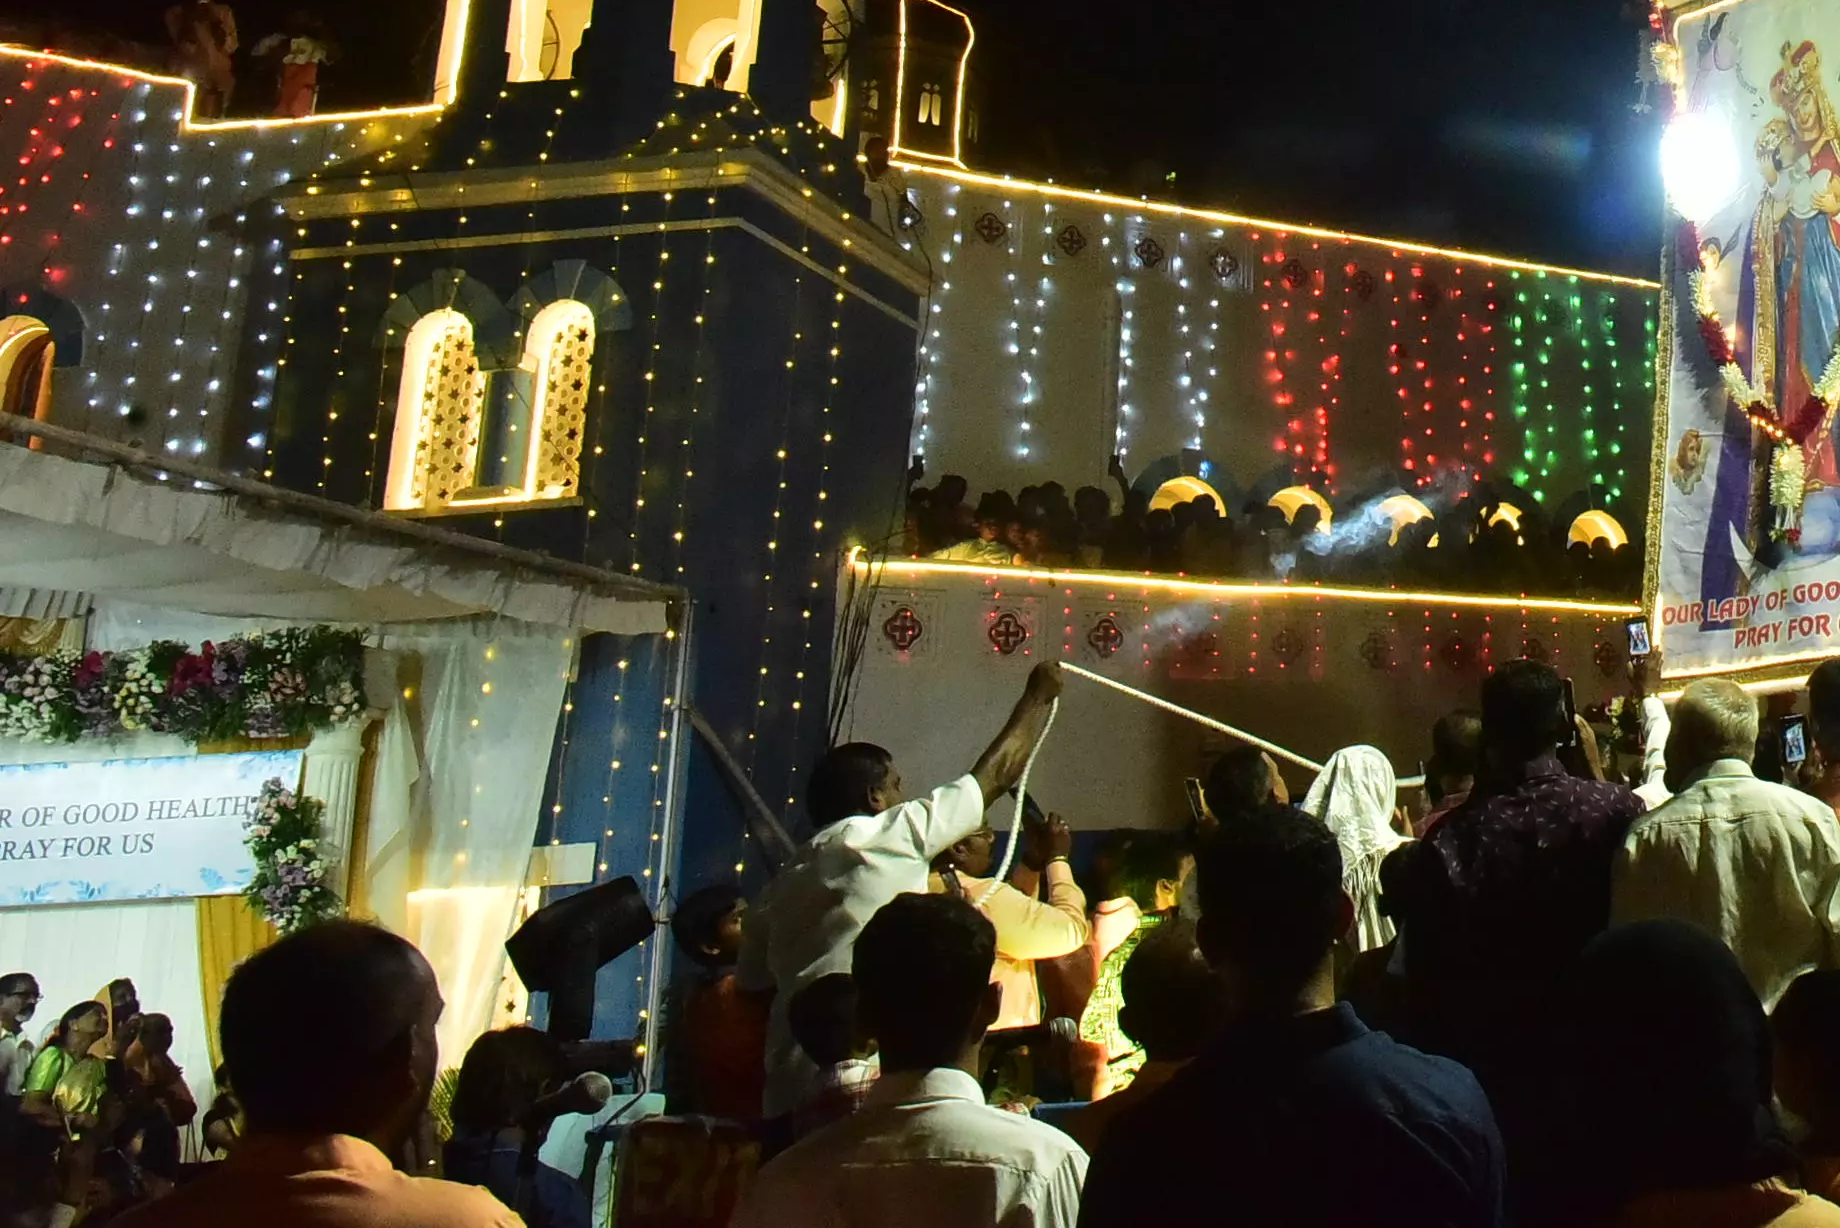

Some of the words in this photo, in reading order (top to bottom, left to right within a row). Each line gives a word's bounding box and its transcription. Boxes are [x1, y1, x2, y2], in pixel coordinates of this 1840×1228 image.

[1661, 603, 1704, 626] OUR
[1708, 594, 1761, 622] LADY
[1765, 588, 1788, 611] OF
[1734, 620, 1783, 649] PRAY
[1788, 614, 1832, 641] FOR
[21, 806, 57, 827] OF
[62, 802, 139, 825] GOOD
[146, 795, 252, 820] HEALTH
[0, 838, 56, 861] RAY
[60, 835, 112, 858] FOR
[121, 832, 155, 855] US
